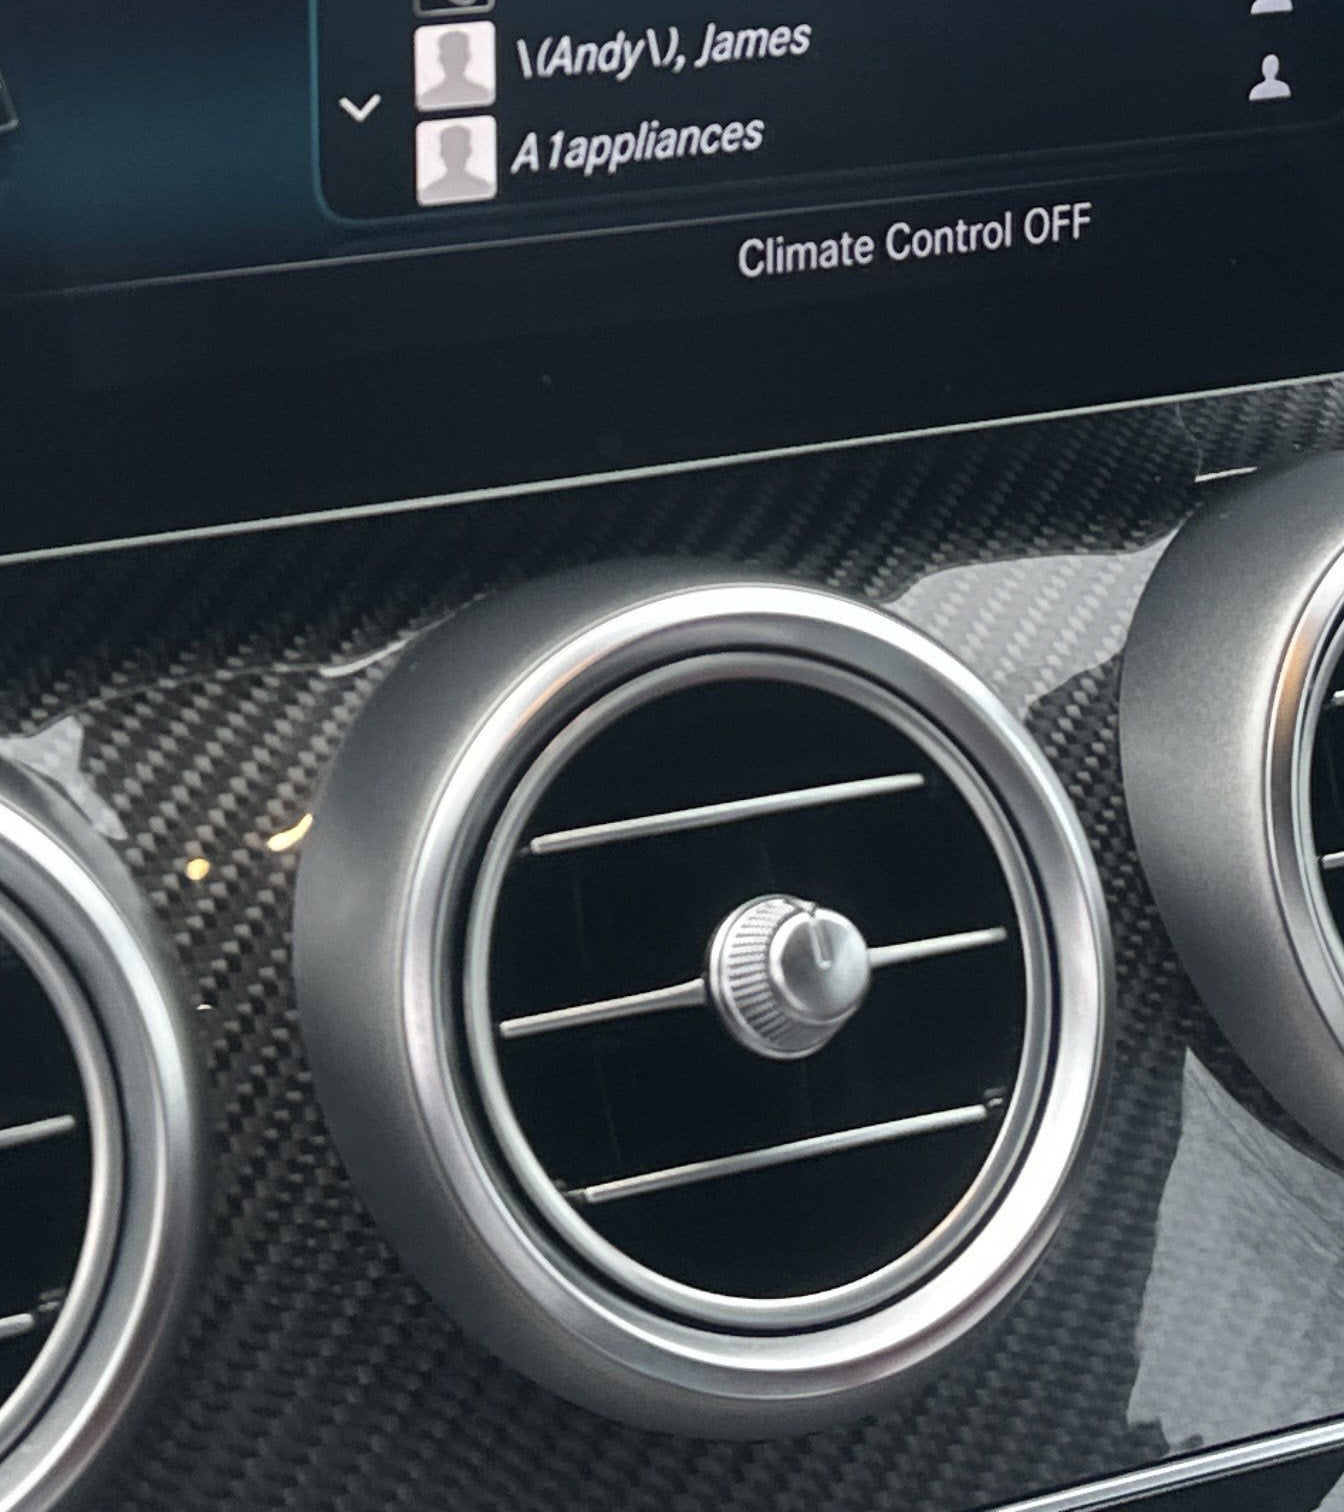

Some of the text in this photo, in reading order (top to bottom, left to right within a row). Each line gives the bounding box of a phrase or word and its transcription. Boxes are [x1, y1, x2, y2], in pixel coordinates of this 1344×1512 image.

[516, 22, 813, 82] \(Andy\), James
[738, 201, 1093, 279] Climate Control OFF
